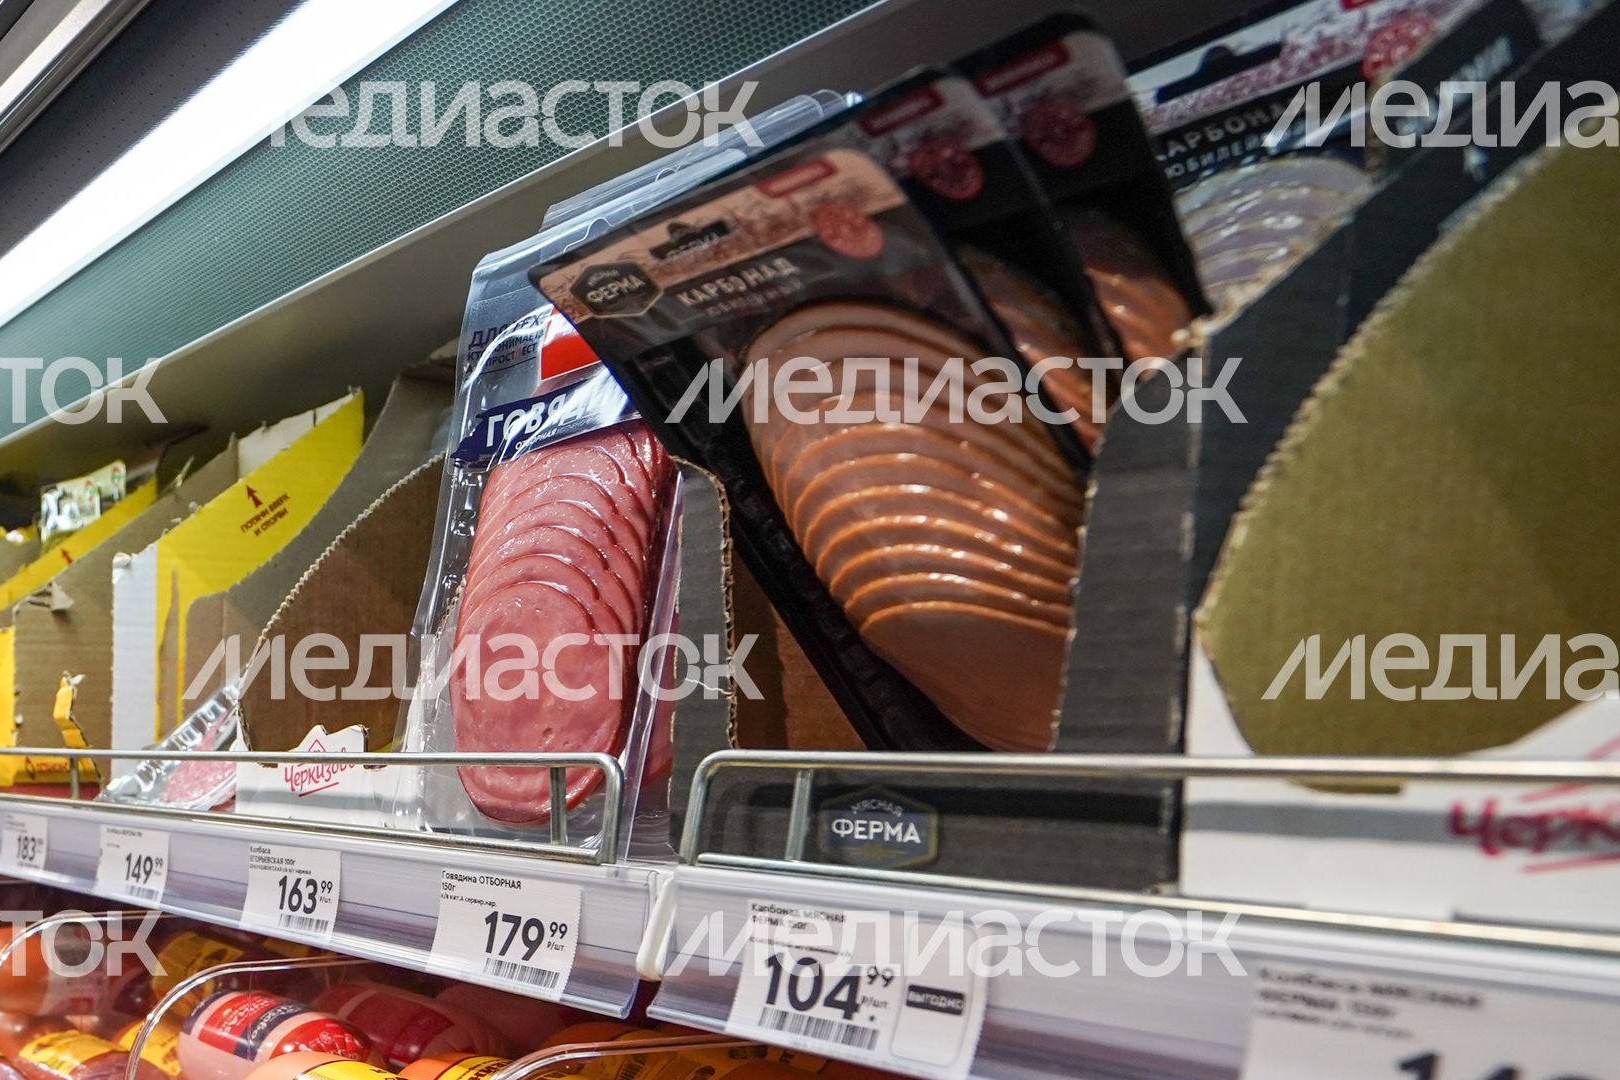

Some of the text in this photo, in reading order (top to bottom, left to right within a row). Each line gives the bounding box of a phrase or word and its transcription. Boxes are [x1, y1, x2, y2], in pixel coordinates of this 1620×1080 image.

[585, 272, 647, 306] ФЕРМА
[677, 256, 801, 308] КАРБОНАД
[831, 818, 922, 844] ФЕРМА
[17, 834, 37, 861] 183
[126, 853, 153, 884] 149
[442, 870, 522, 889] Говядина ОТБОРНАЯ
[279, 875, 333, 914] 163 99
[442, 882, 456, 892] 150г
[485, 911, 568, 961] 179 99
[765, 951, 895, 1022] 104 99
